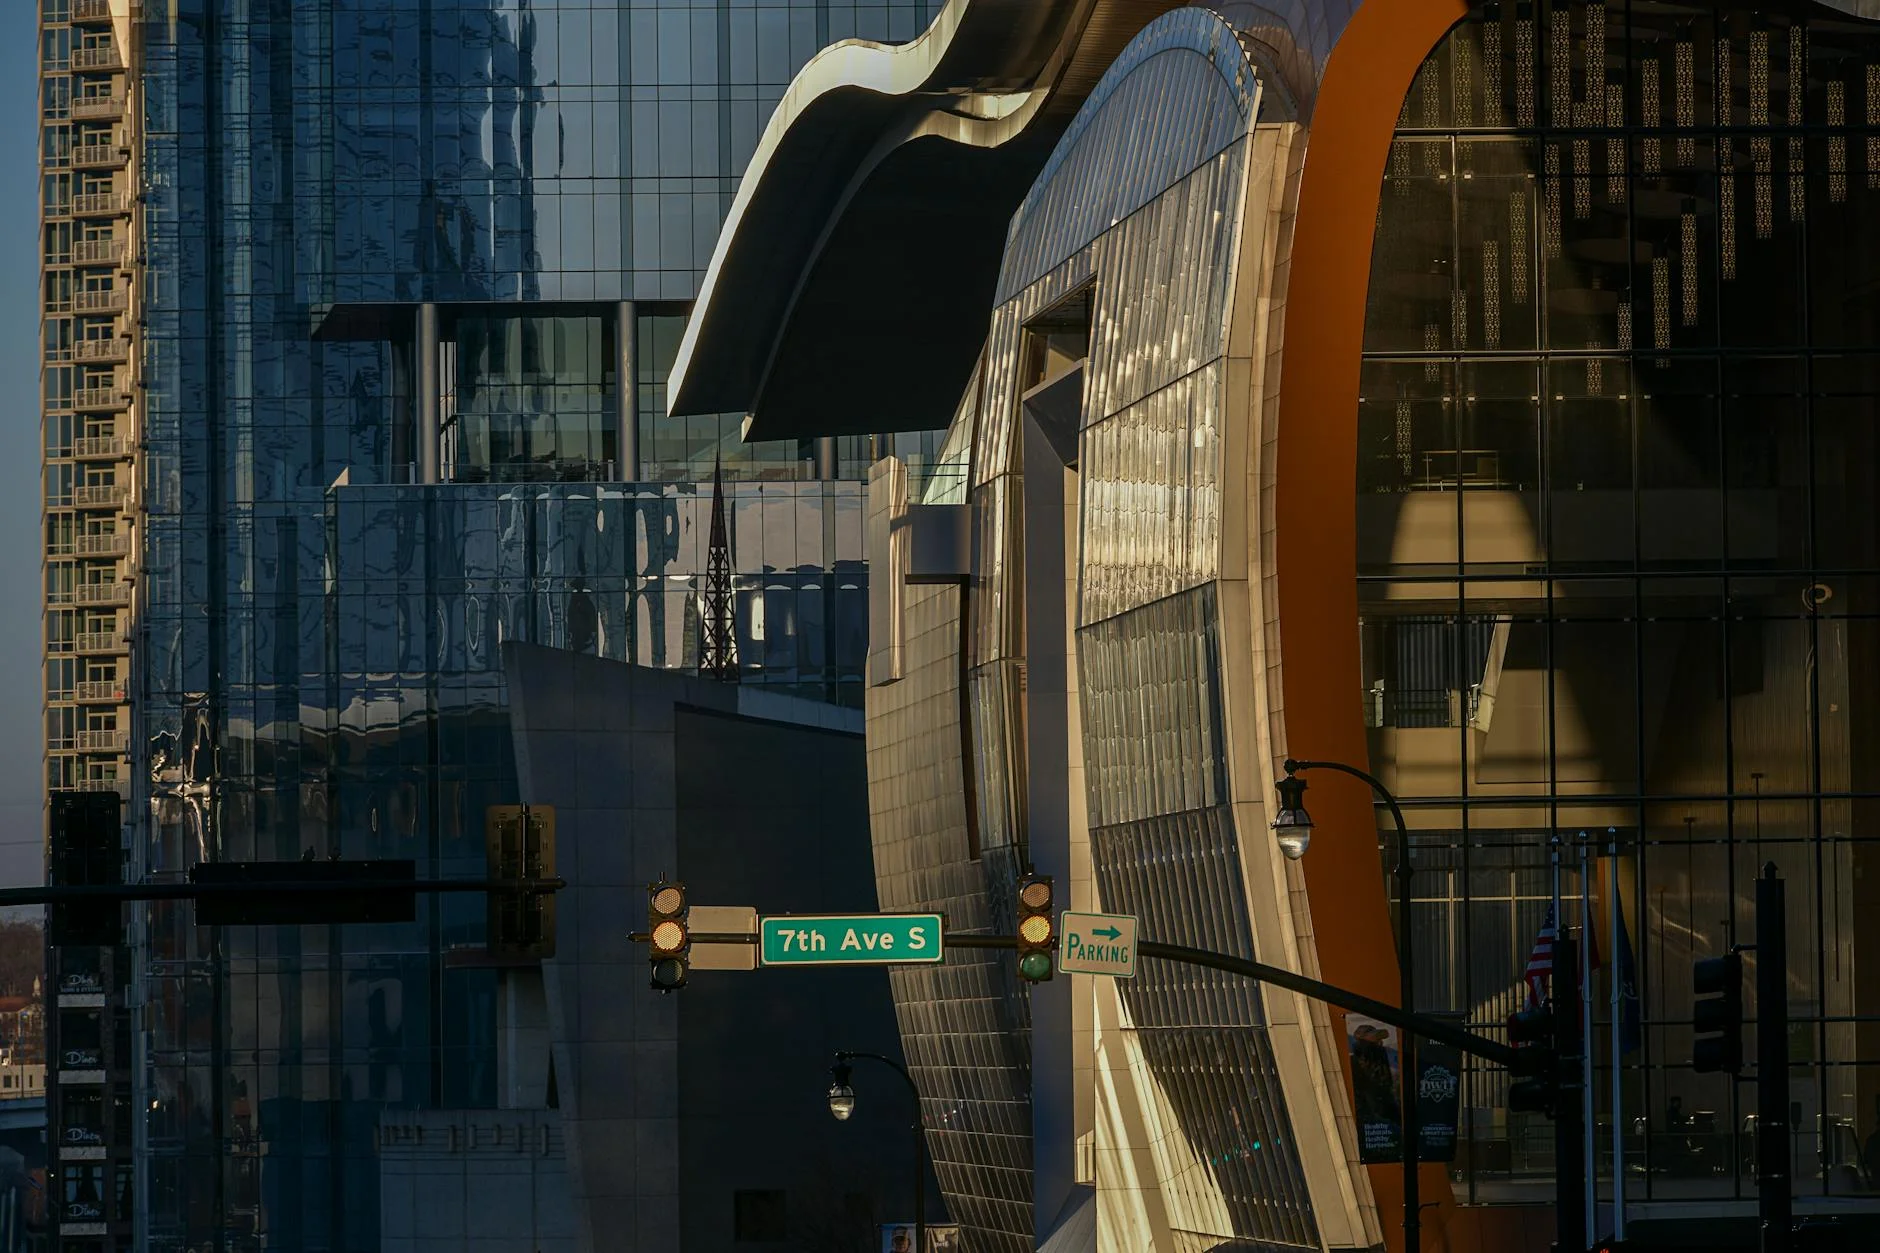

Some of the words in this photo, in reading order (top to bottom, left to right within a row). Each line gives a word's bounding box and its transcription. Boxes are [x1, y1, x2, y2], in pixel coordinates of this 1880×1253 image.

[777, 929, 826, 952] 7th
[840, 928, 894, 951] Ave
[908, 926, 926, 950] S
